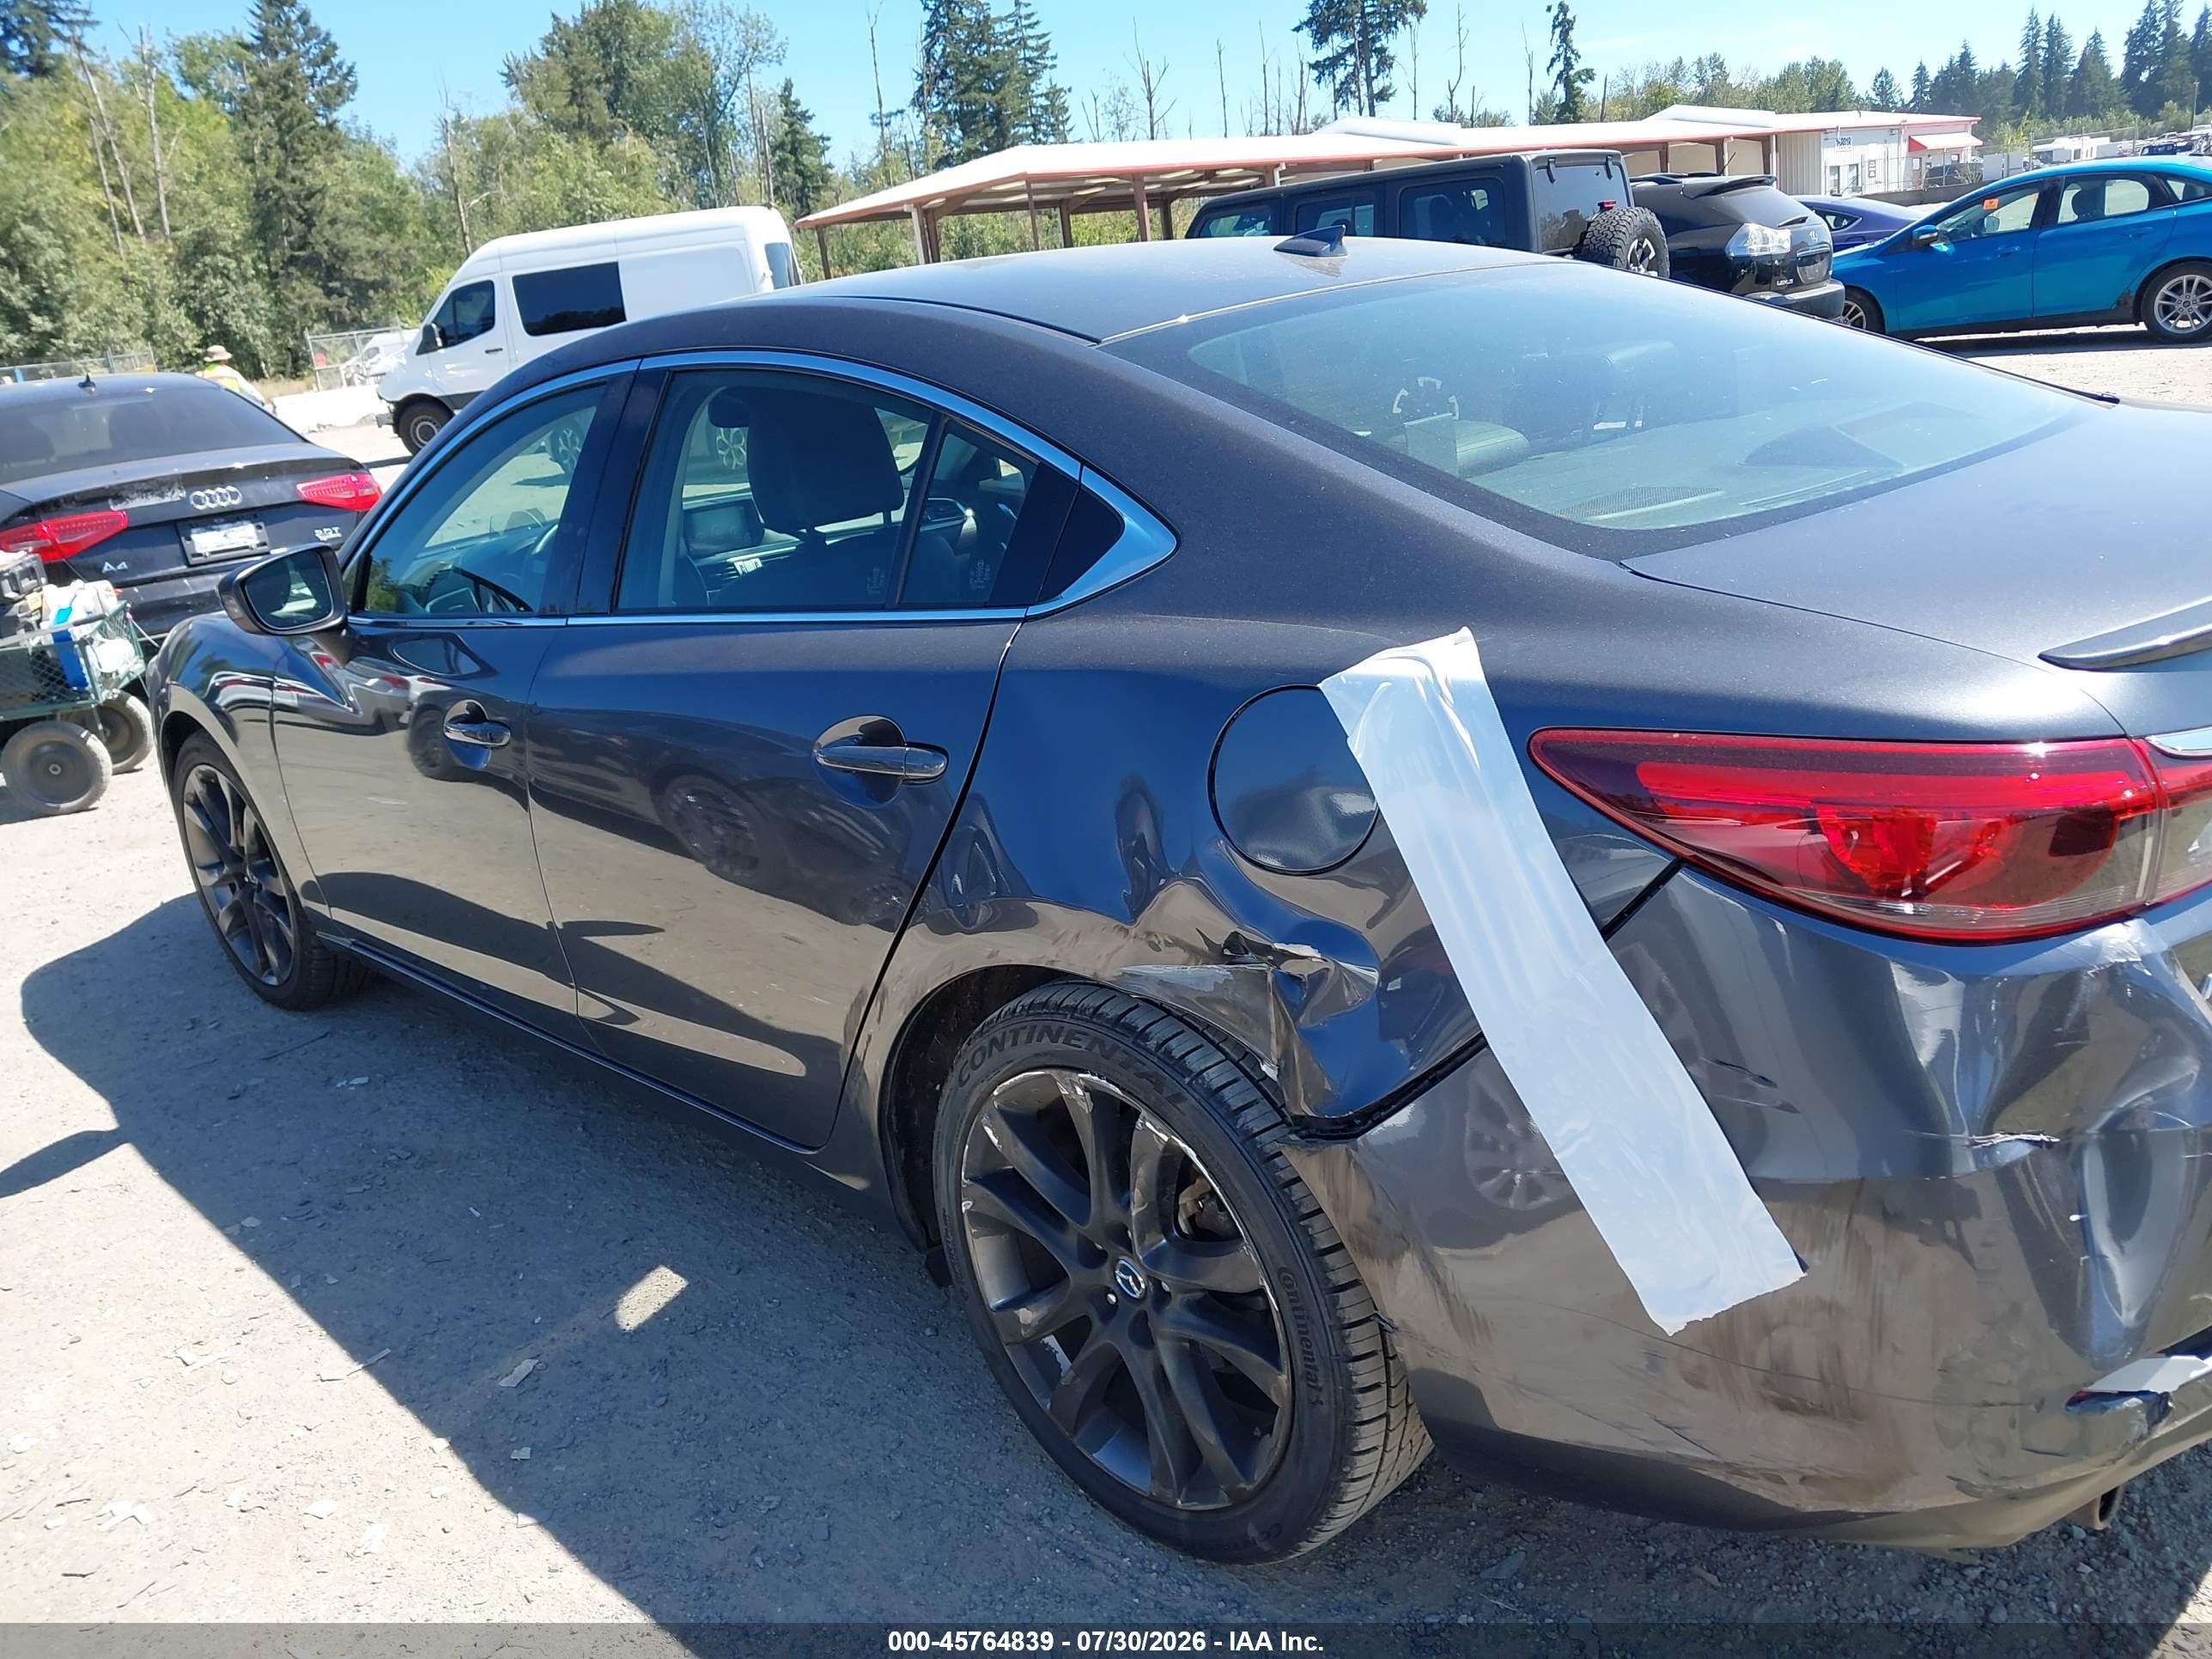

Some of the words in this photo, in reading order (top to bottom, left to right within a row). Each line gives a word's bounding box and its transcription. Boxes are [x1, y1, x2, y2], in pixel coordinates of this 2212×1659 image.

[102, 561, 129, 574] A4
[955, 1024, 1189, 1116] CONTINENTAL
[1277, 1266, 1323, 1392] Continental
